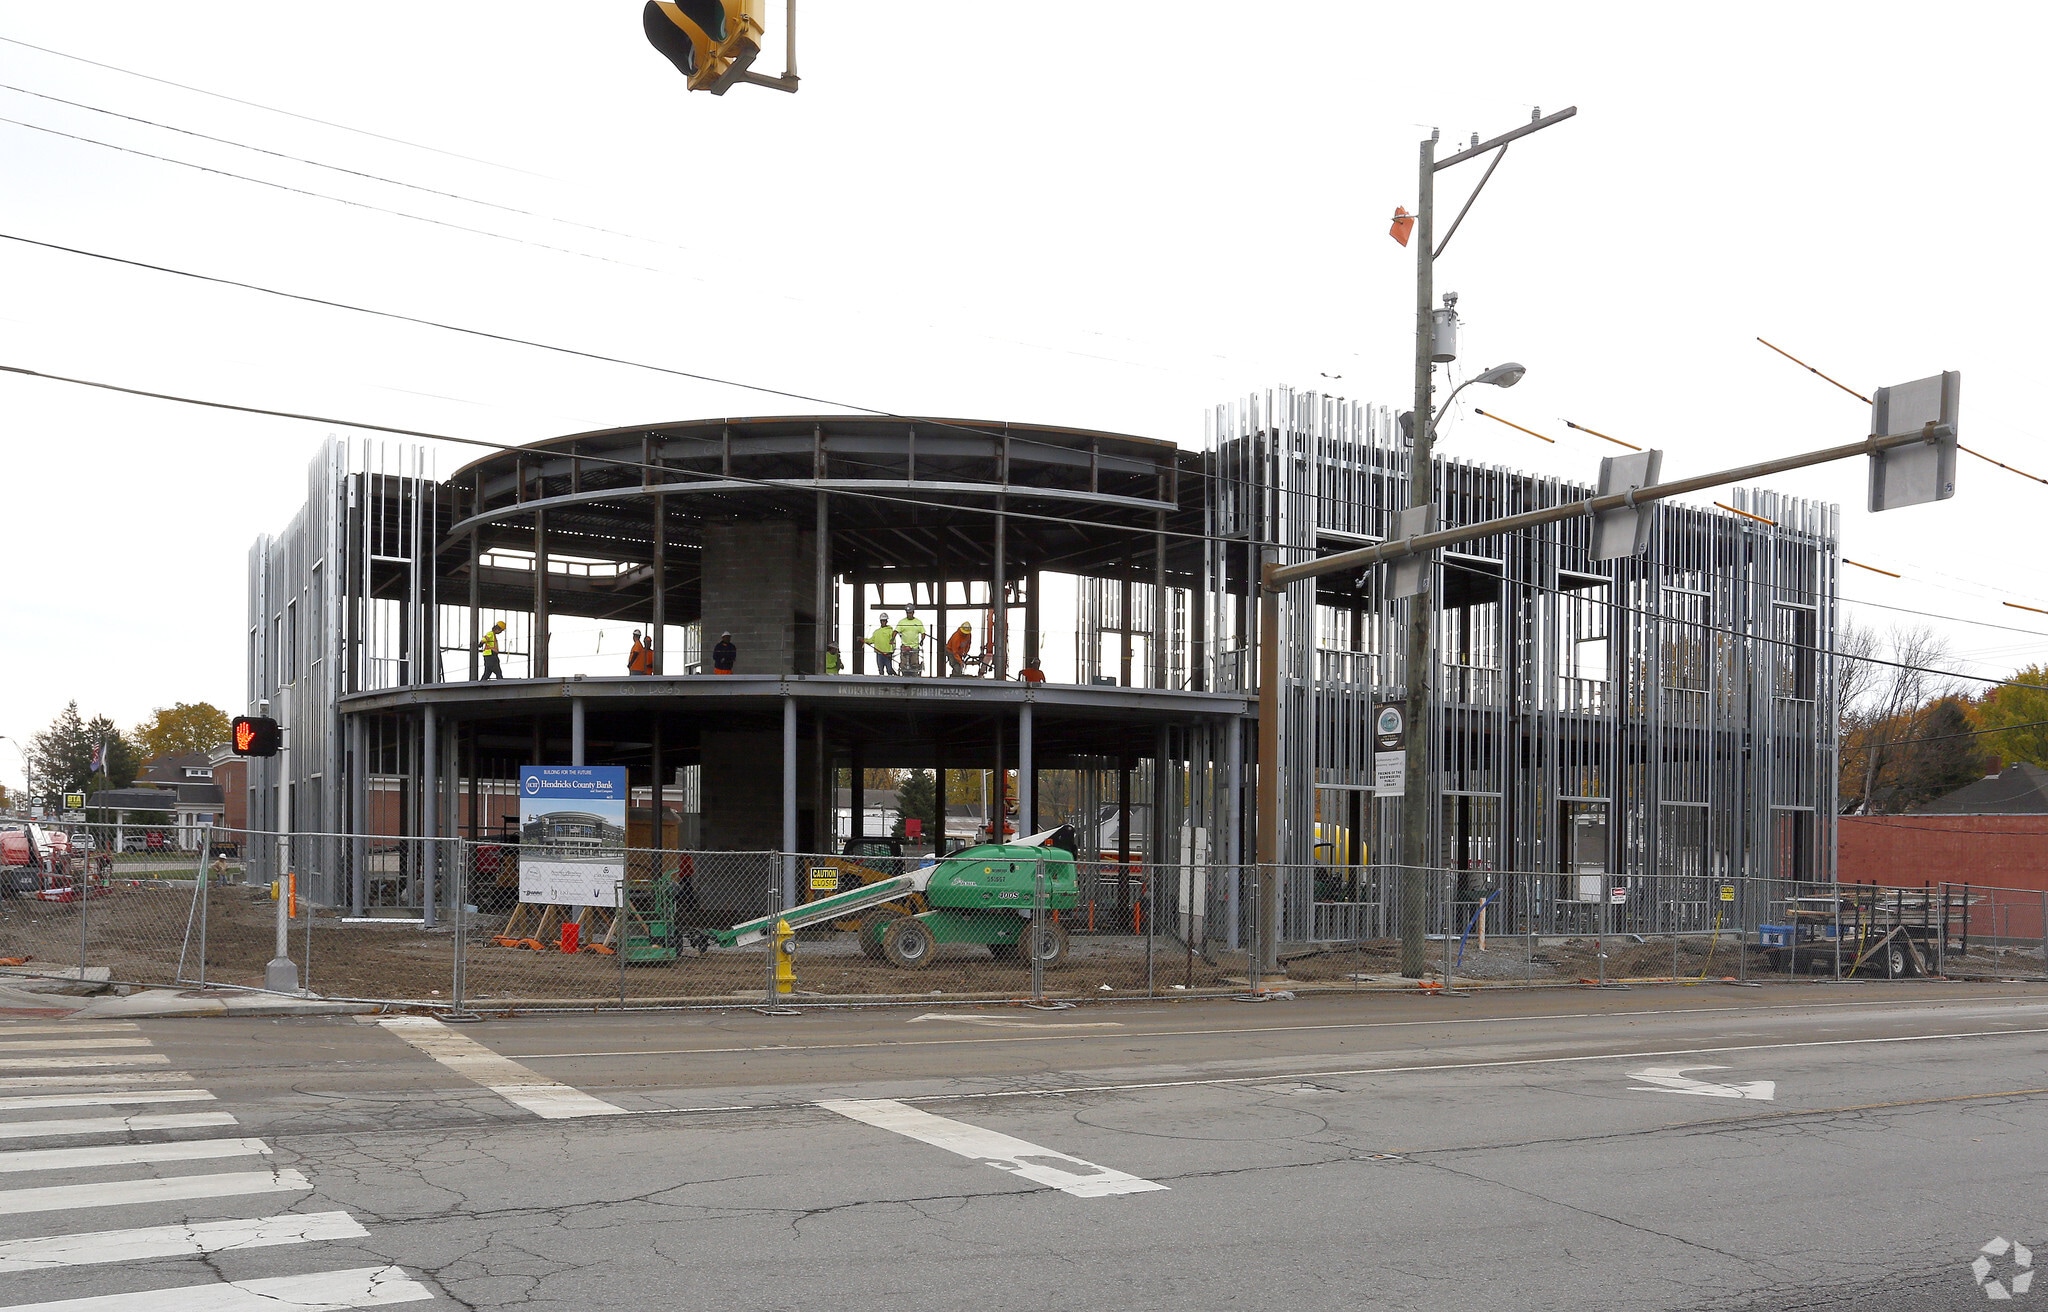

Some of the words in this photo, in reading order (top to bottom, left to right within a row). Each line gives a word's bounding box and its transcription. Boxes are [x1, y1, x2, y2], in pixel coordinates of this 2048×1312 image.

[541, 780, 571, 788] Hendricks
[572, 780, 596, 790] County
[596, 781, 613, 789] Bank
[67, 795, 82, 803] BTA
[812, 869, 837, 878] CAUTION
[812, 879, 837, 887] CLOSED
[998, 891, 1019, 900] 400S
